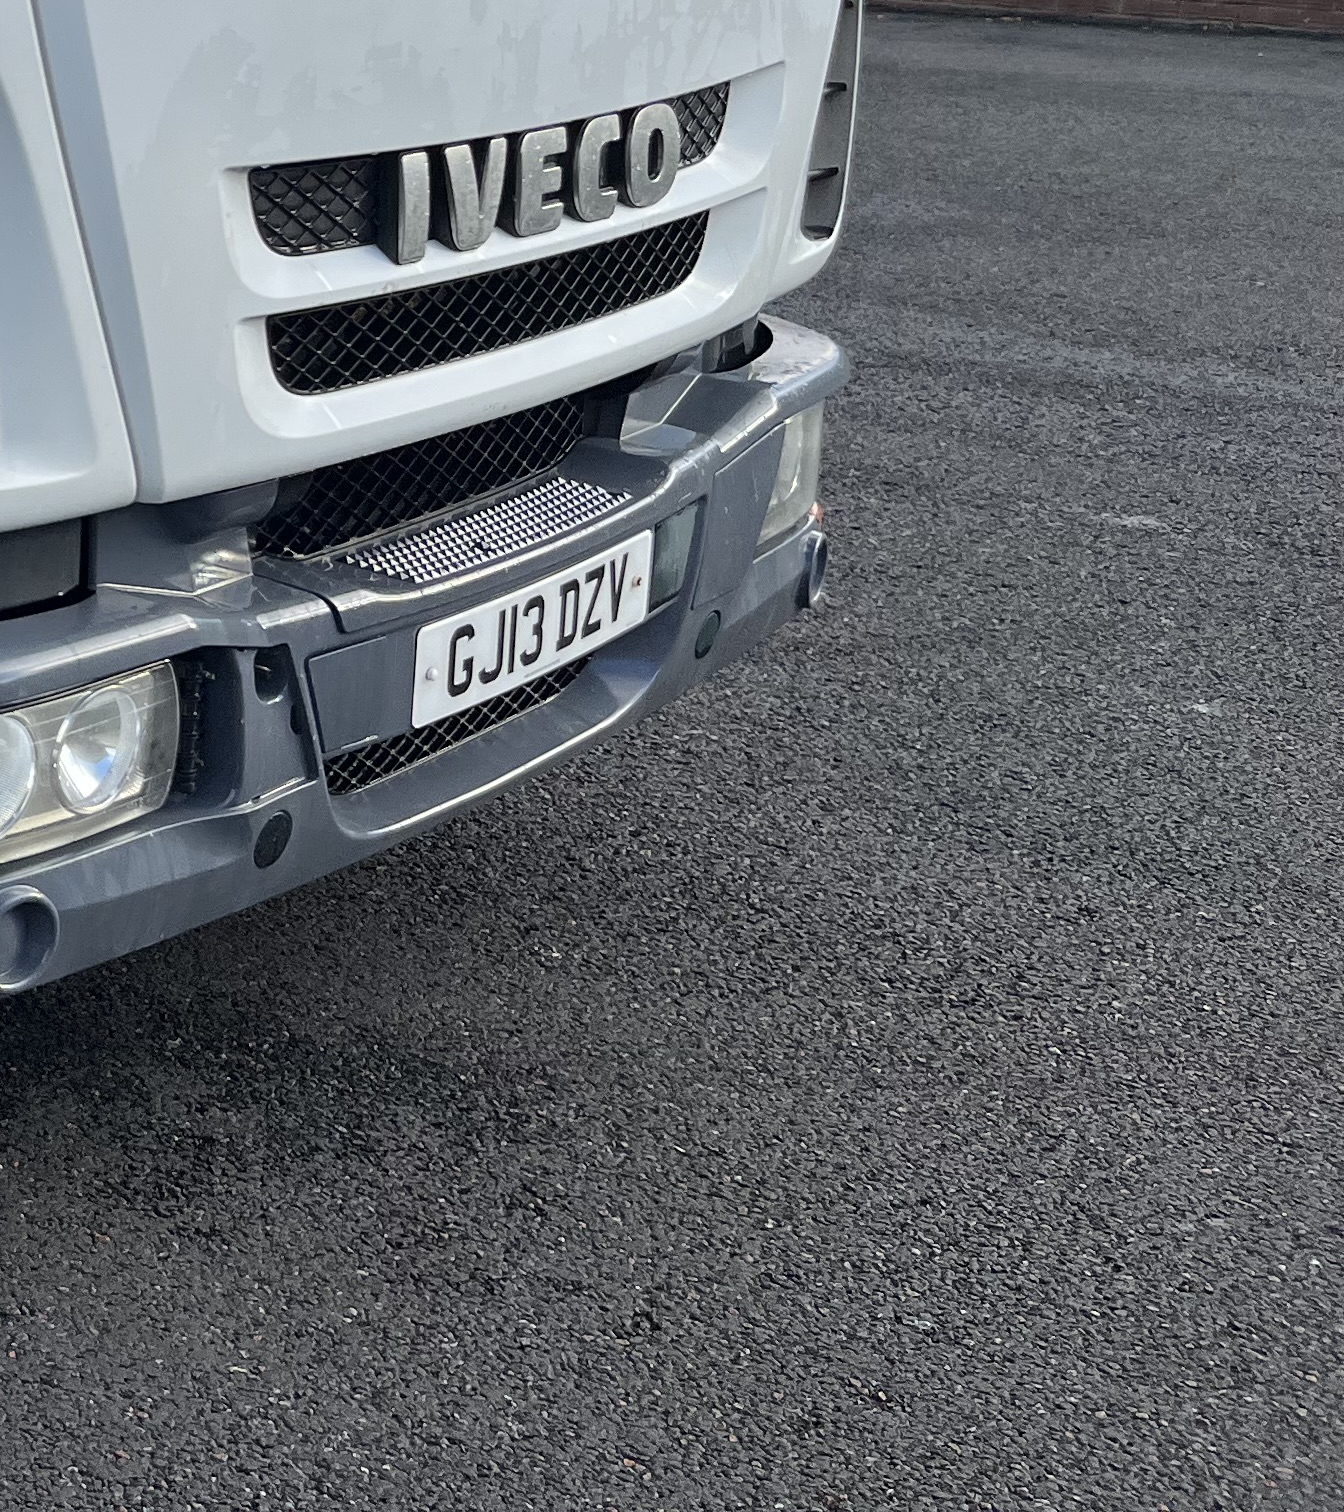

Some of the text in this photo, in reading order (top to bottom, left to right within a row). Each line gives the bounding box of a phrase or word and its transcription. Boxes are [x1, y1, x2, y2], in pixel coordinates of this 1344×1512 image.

[394, 103, 681, 265] IVECO
[446, 552, 630, 697] GJ13 DZV
